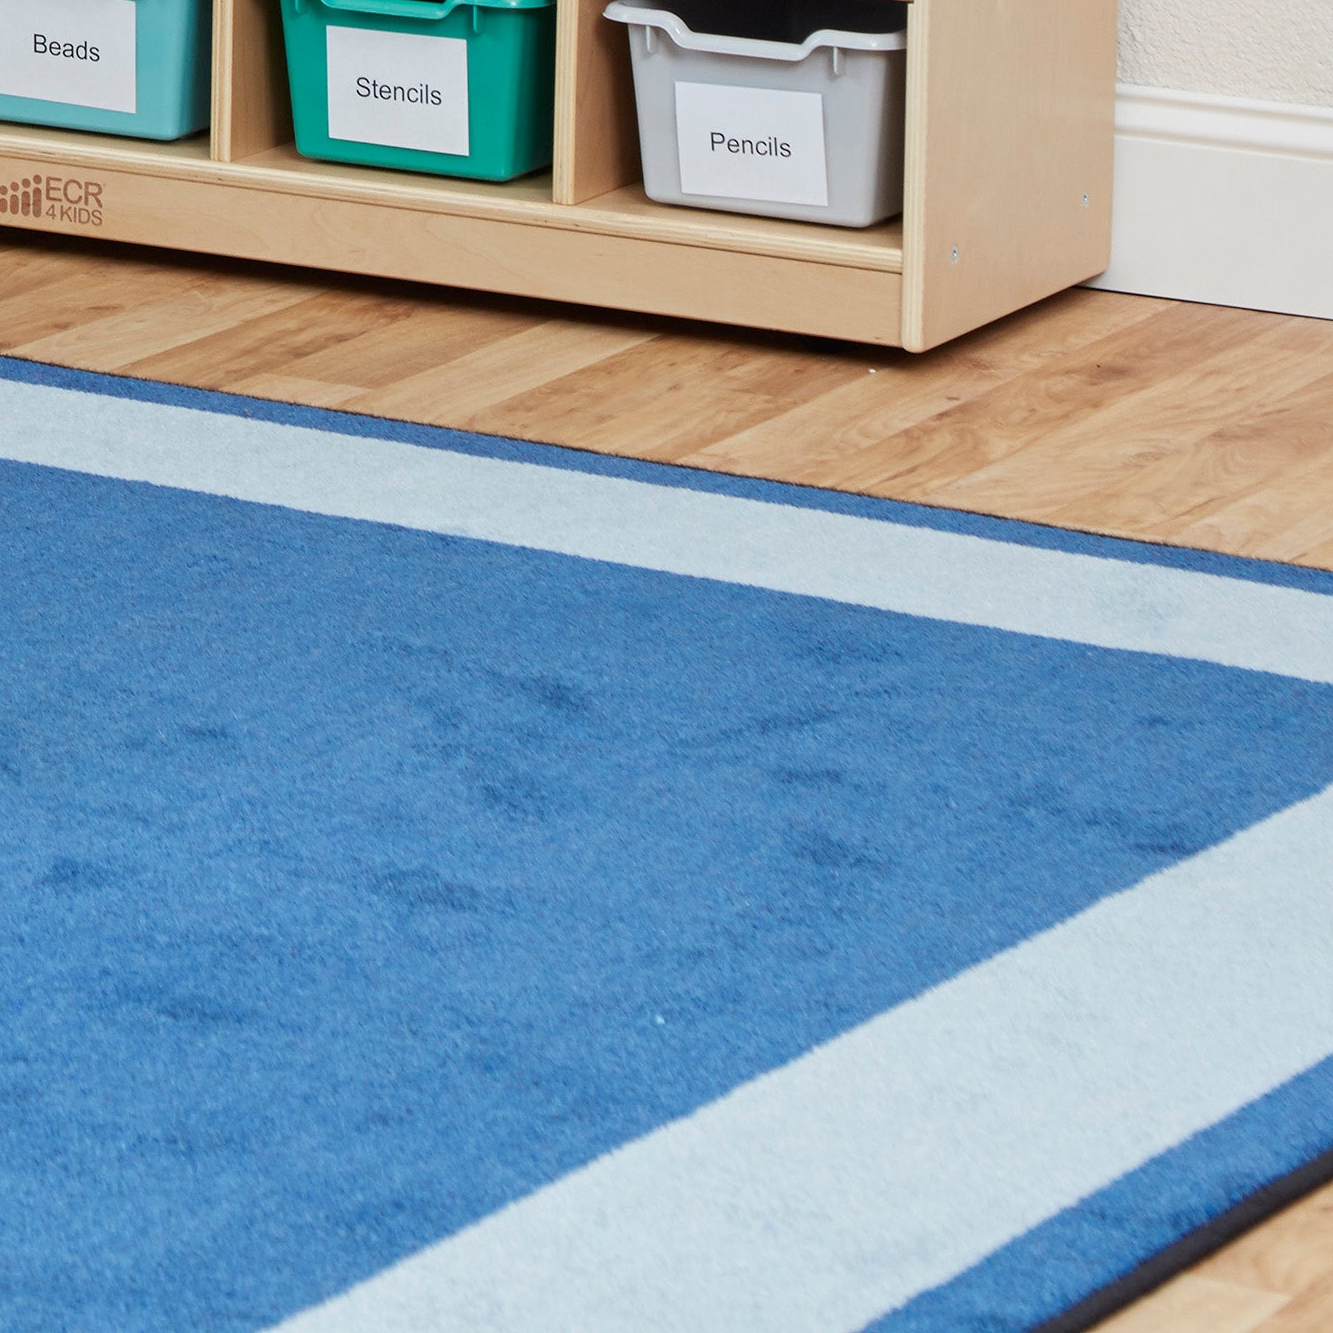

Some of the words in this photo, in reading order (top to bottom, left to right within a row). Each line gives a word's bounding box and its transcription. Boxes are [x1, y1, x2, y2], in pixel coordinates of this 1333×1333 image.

[34, 34, 99, 61] Beads
[357, 77, 441, 105] Stencils
[711, 132, 791, 157] Pencils
[46, 177, 103, 208] ECR
